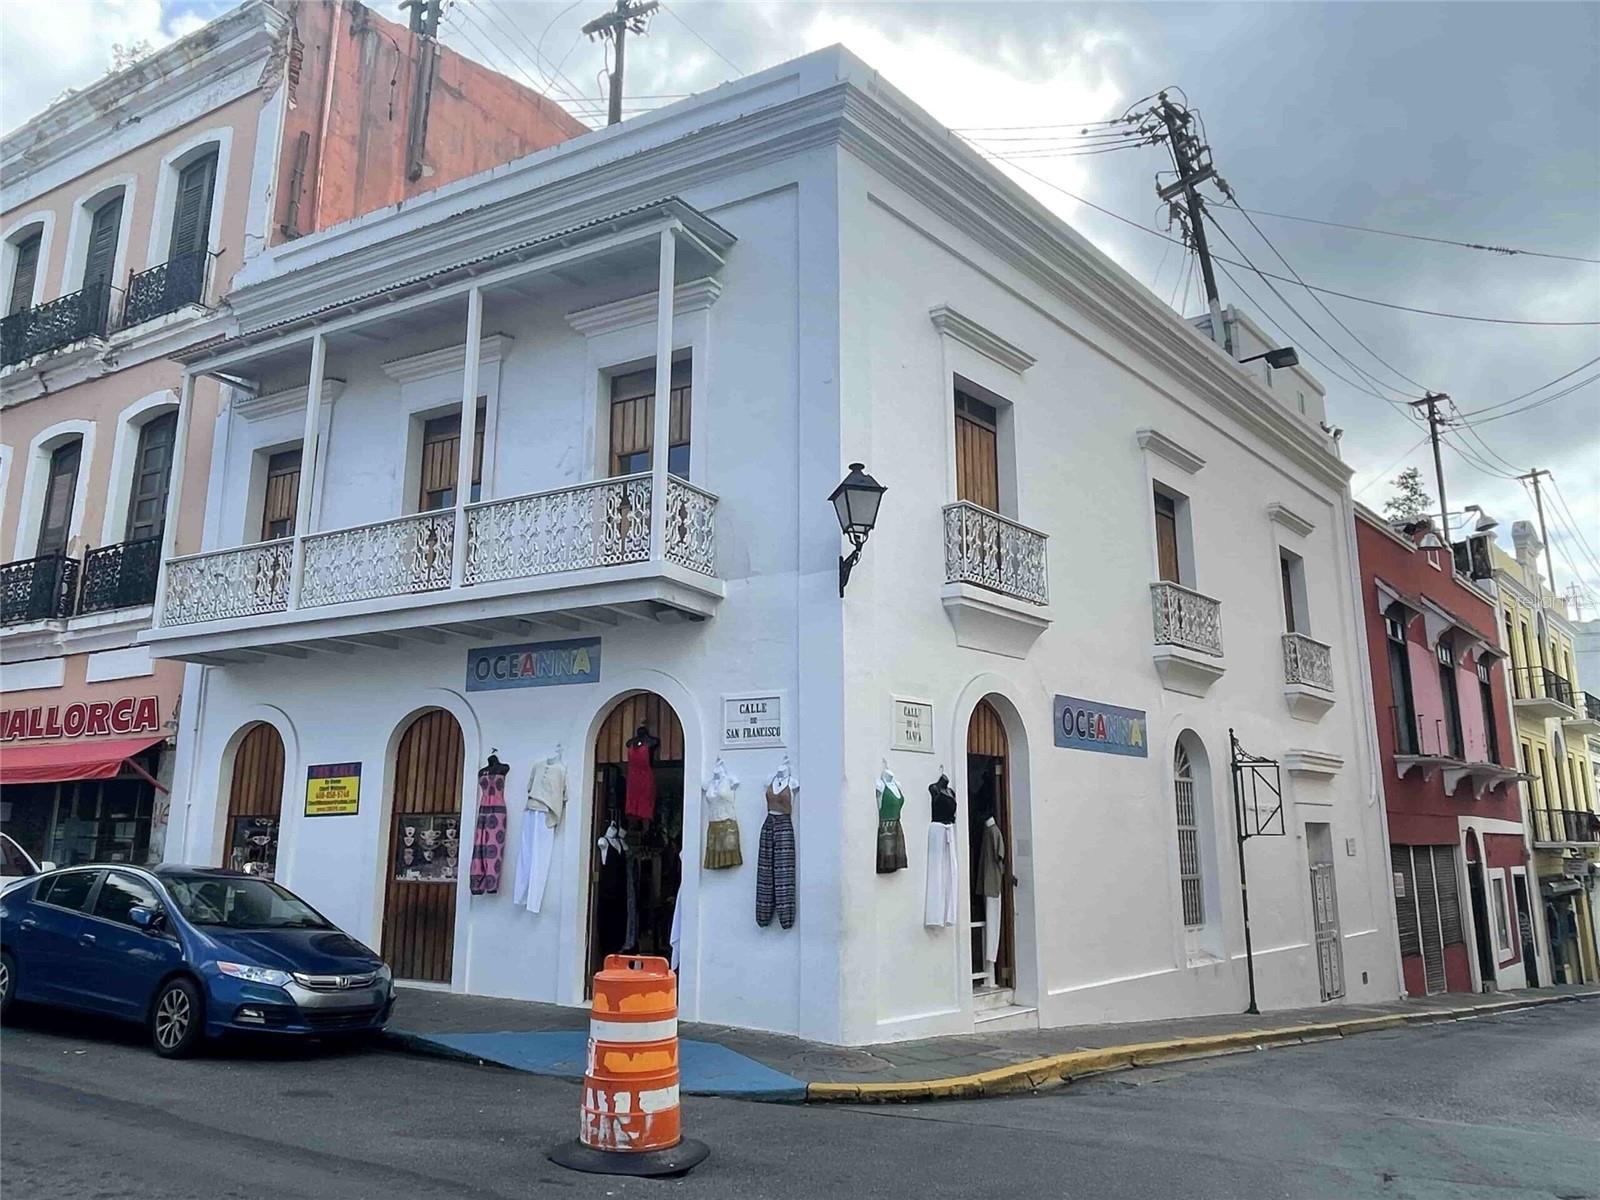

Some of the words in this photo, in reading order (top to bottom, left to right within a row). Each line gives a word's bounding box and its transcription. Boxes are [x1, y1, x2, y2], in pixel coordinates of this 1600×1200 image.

[475, 647, 591, 681] OCEANNA
[739, 702, 767, 714] CALLE
[726, 728, 739, 739] SAN
[743, 726, 781, 738] FRANCISCO
[1062, 706, 1142, 747] OCEANNA
